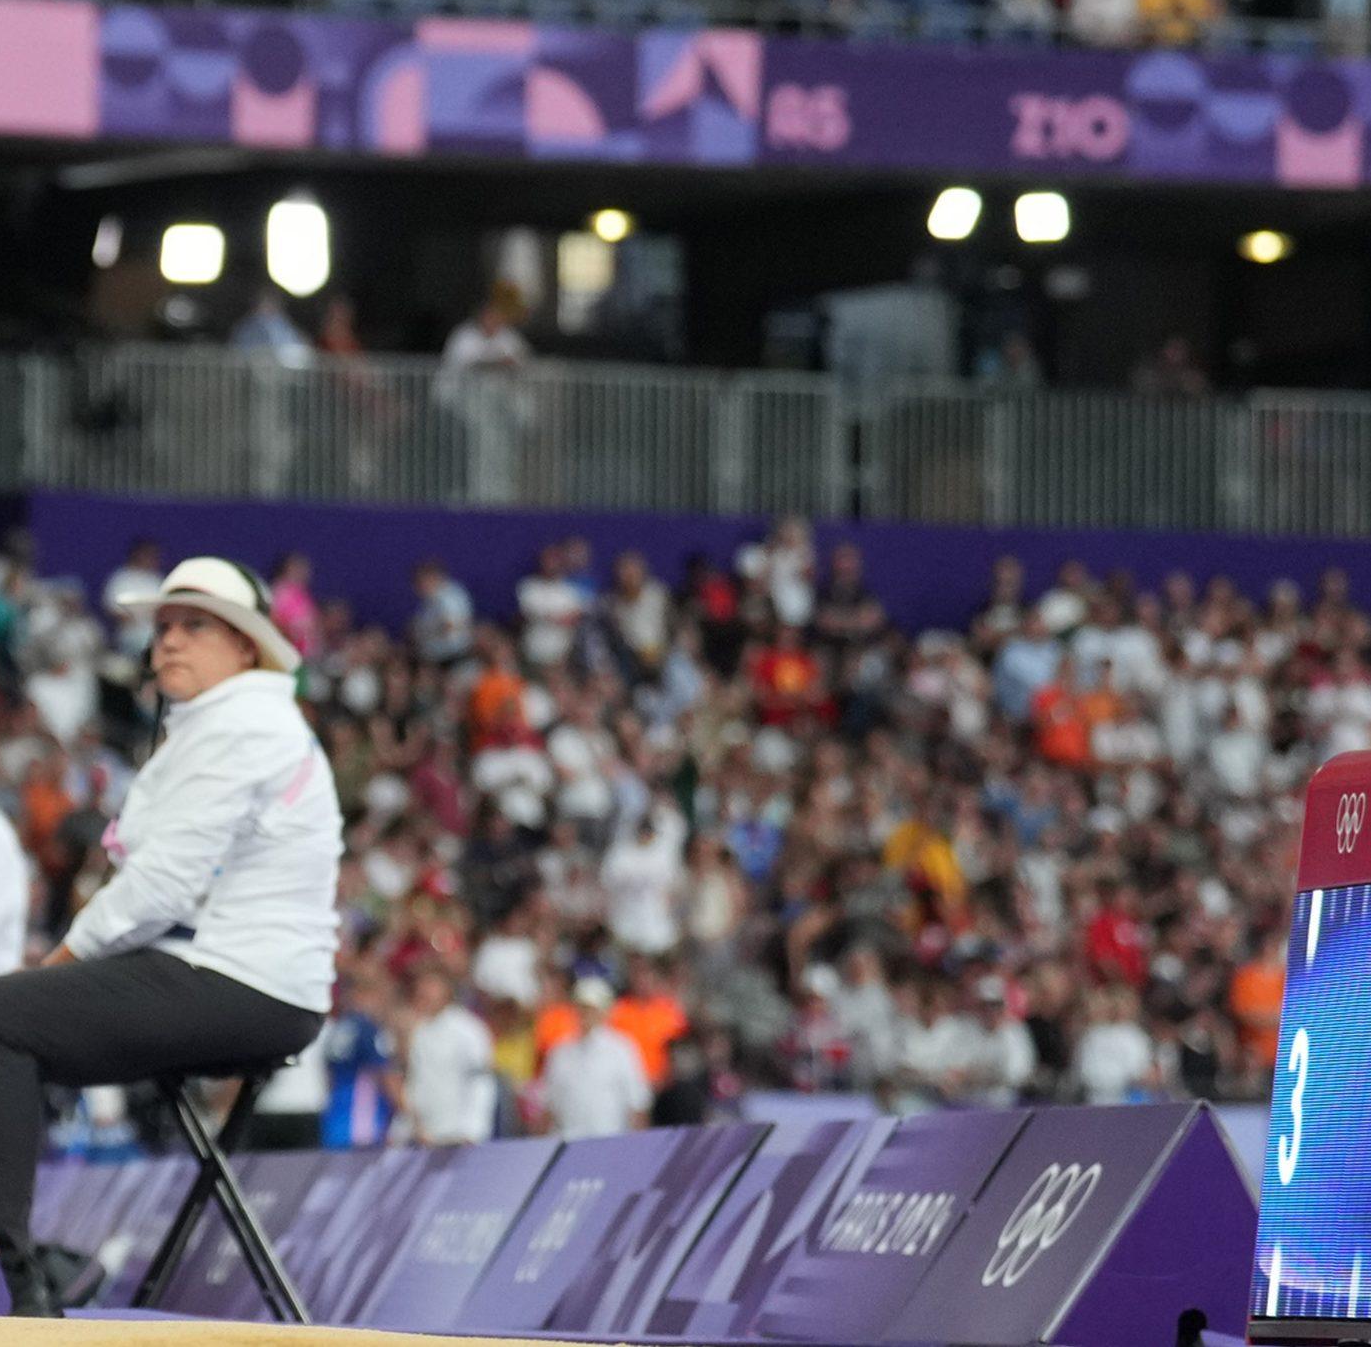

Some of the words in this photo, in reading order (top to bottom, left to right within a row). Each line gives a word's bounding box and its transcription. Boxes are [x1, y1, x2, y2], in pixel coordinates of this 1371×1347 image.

[1279, 1028, 1309, 1185] 3
[819, 1190, 906, 1254] PARIS
[873, 1191, 957, 1256] 2024
